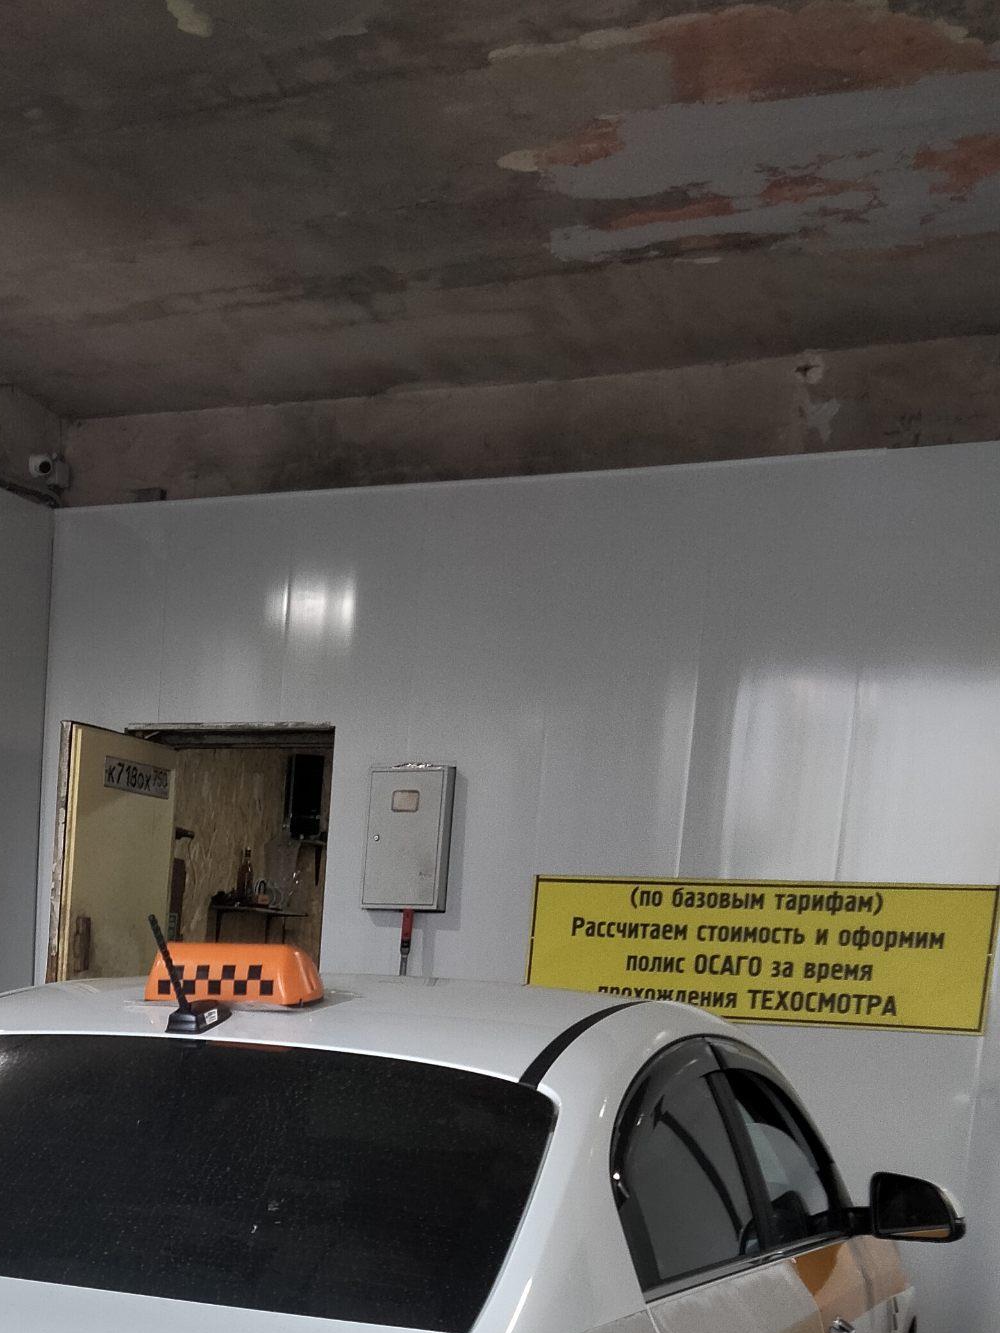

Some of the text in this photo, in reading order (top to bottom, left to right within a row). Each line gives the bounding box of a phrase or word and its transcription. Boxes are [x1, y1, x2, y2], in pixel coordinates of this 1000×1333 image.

[630, 886, 883, 916] (по базовым тарифам)
[571, 916, 945, 952] Рассчитаем стоимость и оформим
[625, 953, 873, 983] полис ОСАГО за время
[746, 988, 898, 1017] ТЕХОСМОТРА
